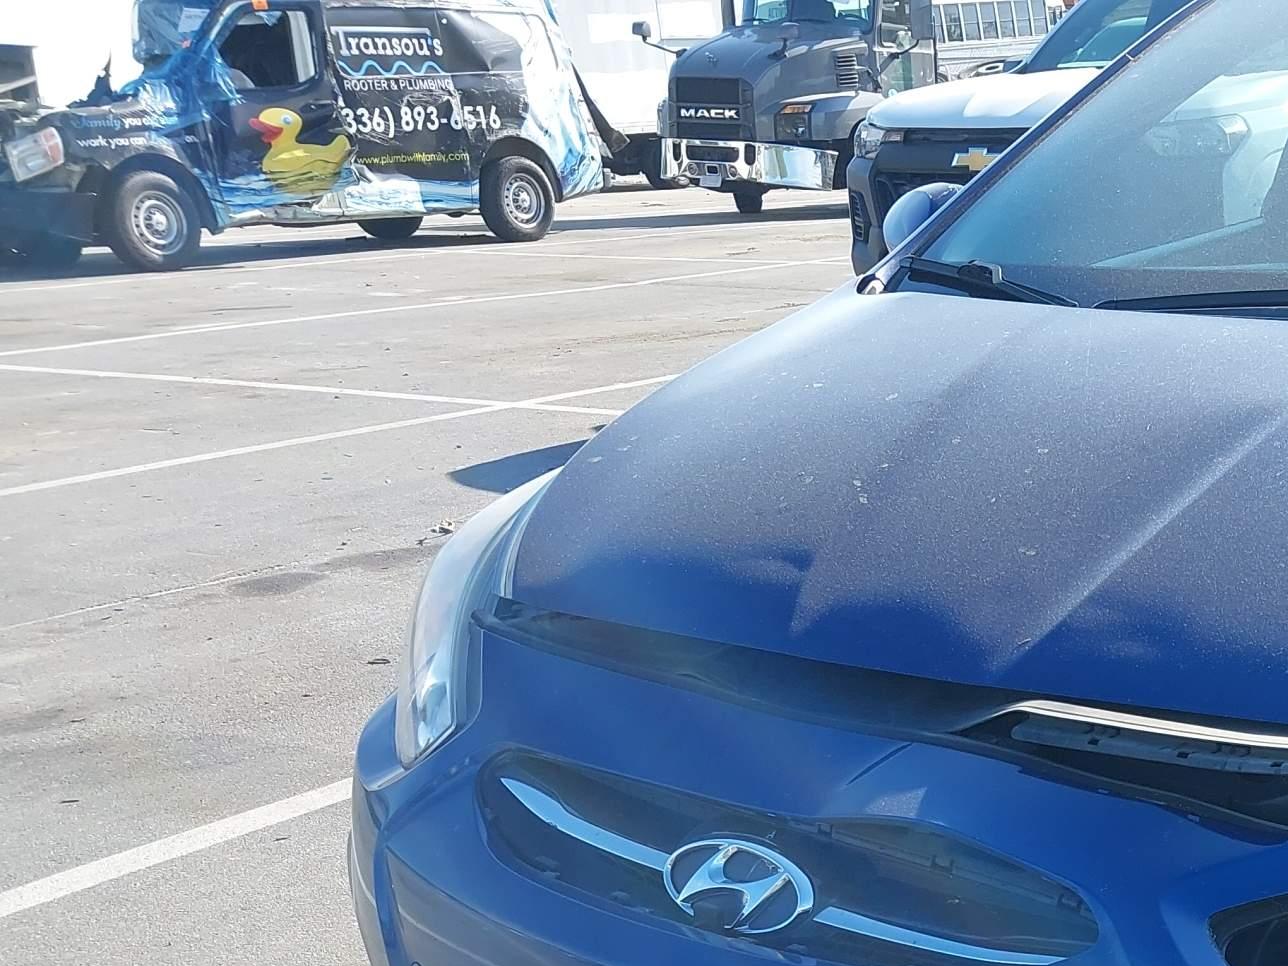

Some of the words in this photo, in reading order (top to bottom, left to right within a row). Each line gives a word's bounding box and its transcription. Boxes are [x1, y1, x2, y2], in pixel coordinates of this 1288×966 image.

[331, 26, 444, 57] Transou's
[344, 78, 387, 91] ROOTER
[390, 78, 398, 90] &
[400, 78, 455, 91] PLUMBING
[401, 104, 502, 132] 893-6516
[680, 108, 739, 119] MACK
[108, 137, 129, 149] you
